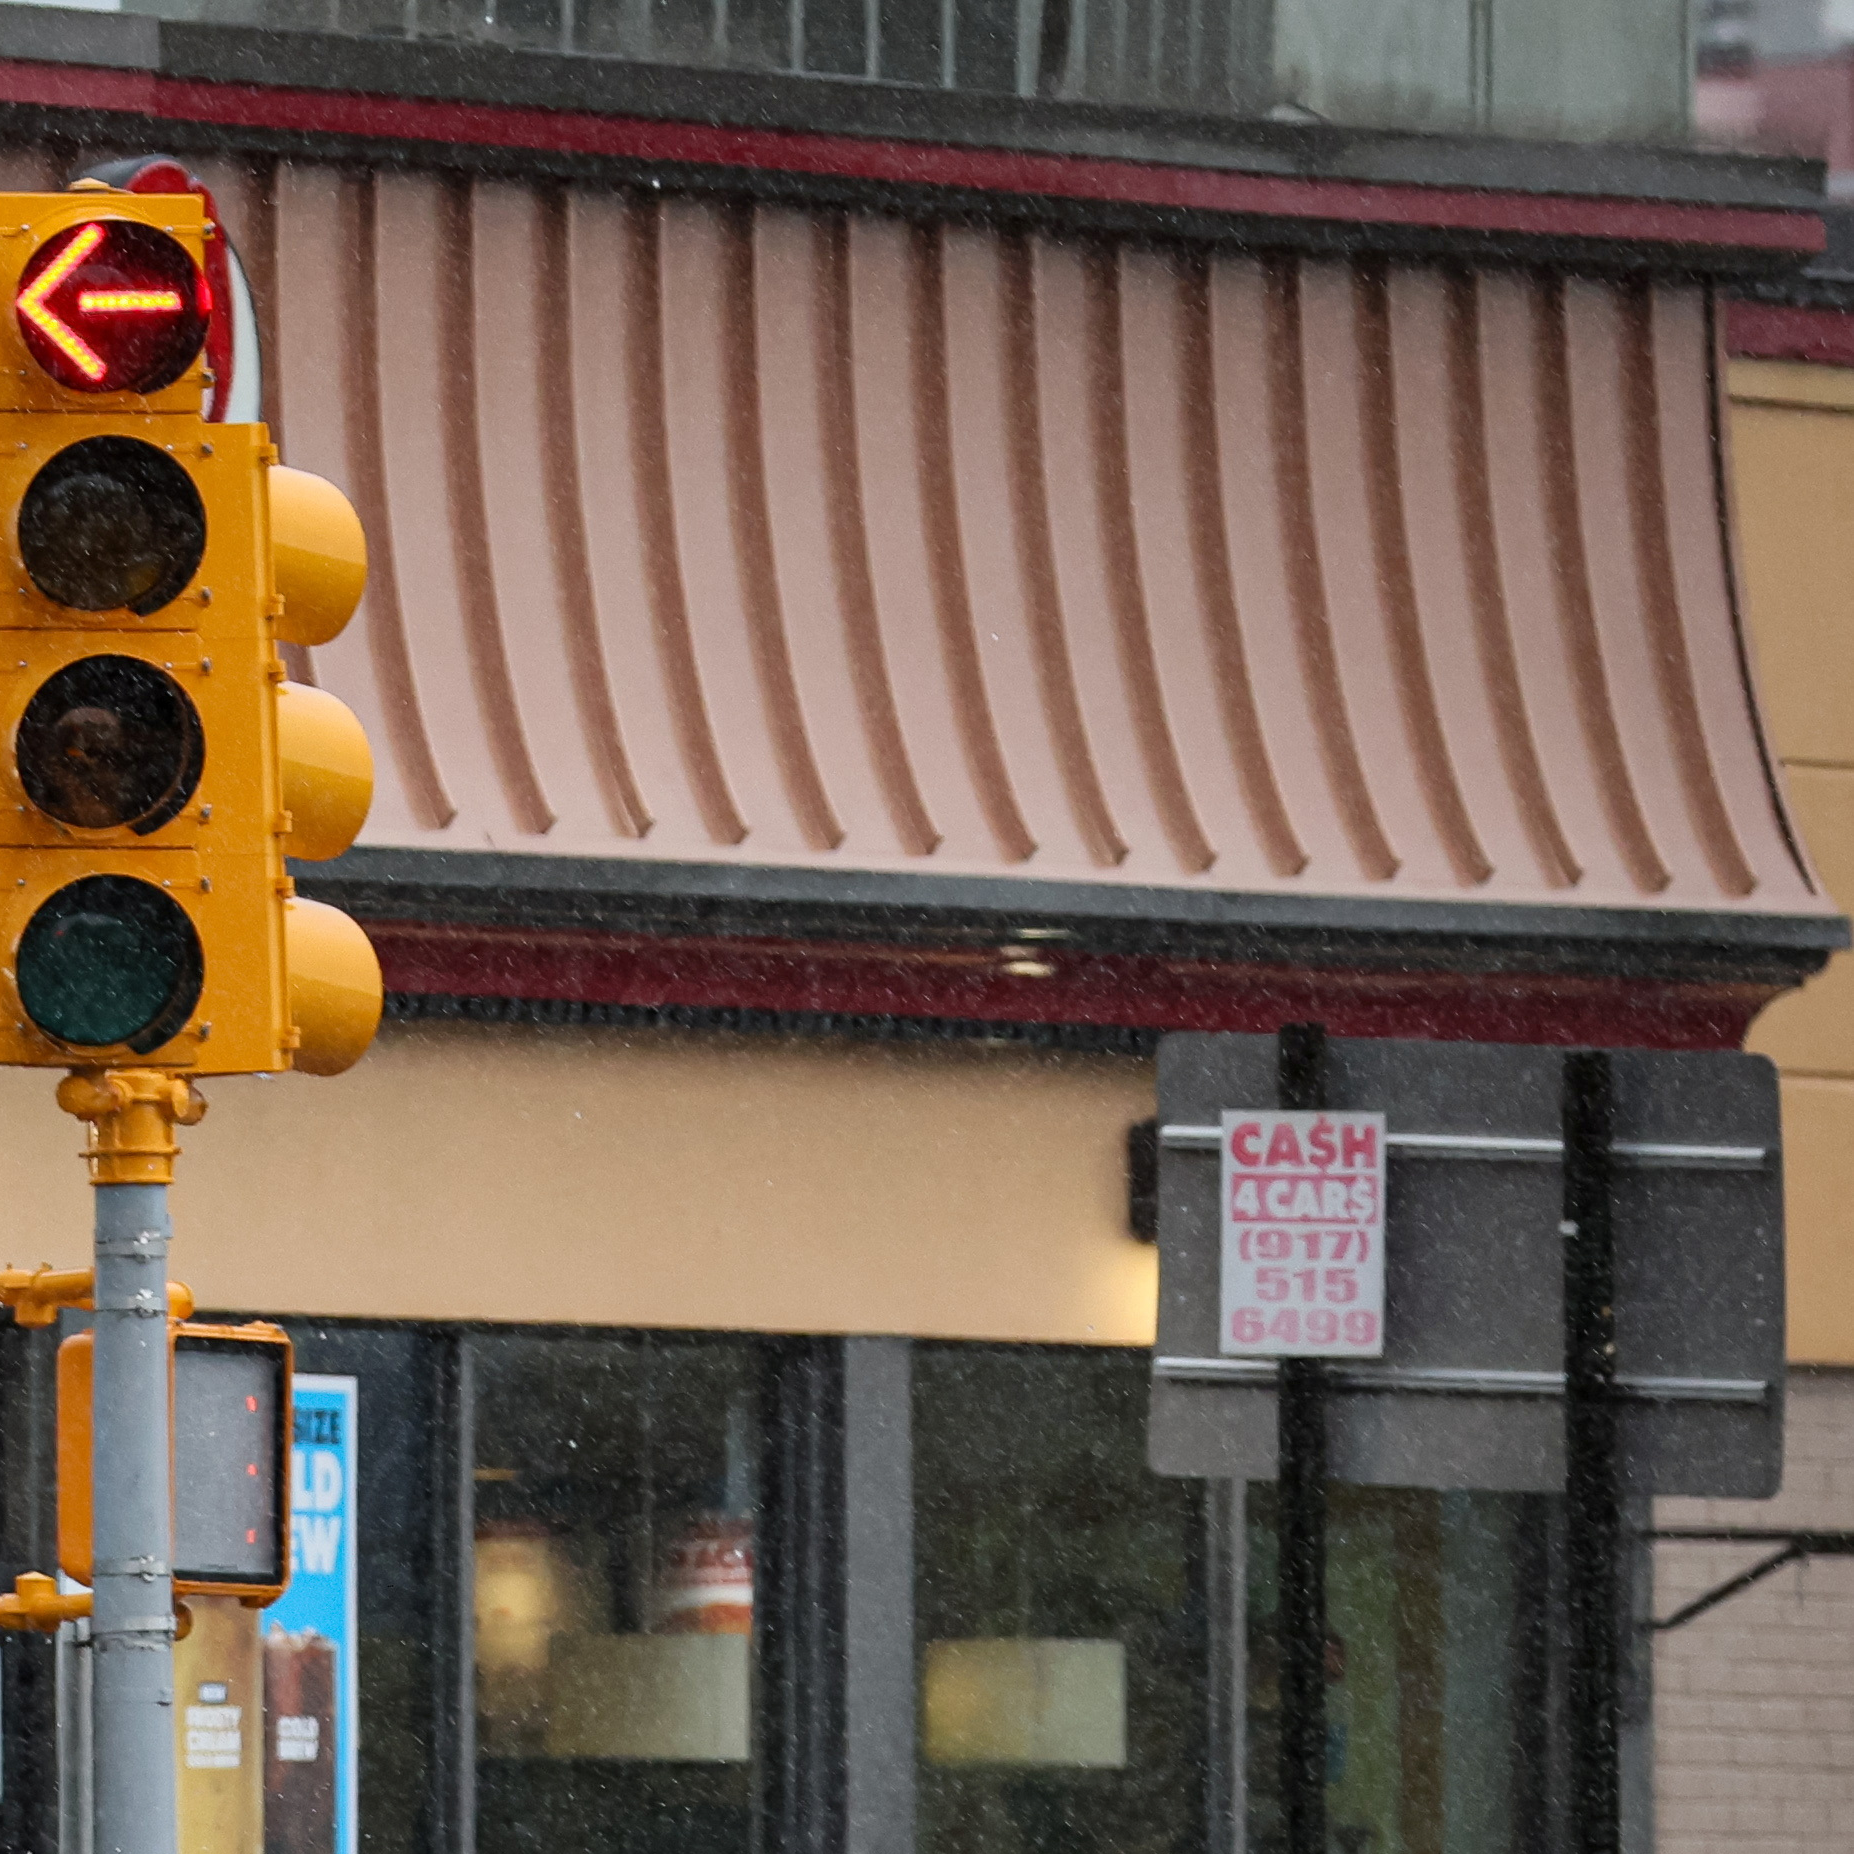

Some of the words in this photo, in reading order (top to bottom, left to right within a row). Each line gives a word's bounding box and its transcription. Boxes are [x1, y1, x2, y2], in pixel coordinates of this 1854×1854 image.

[1230, 1113, 1377, 1172] CA$H
[1235, 1180, 1262, 1218] 4
[1265, 1174, 1375, 1225] CAR$
[1238, 1229, 1370, 1263] (917)
[1256, 1267, 1359, 1304] 515
[1231, 1306, 1377, 1345] 6499
